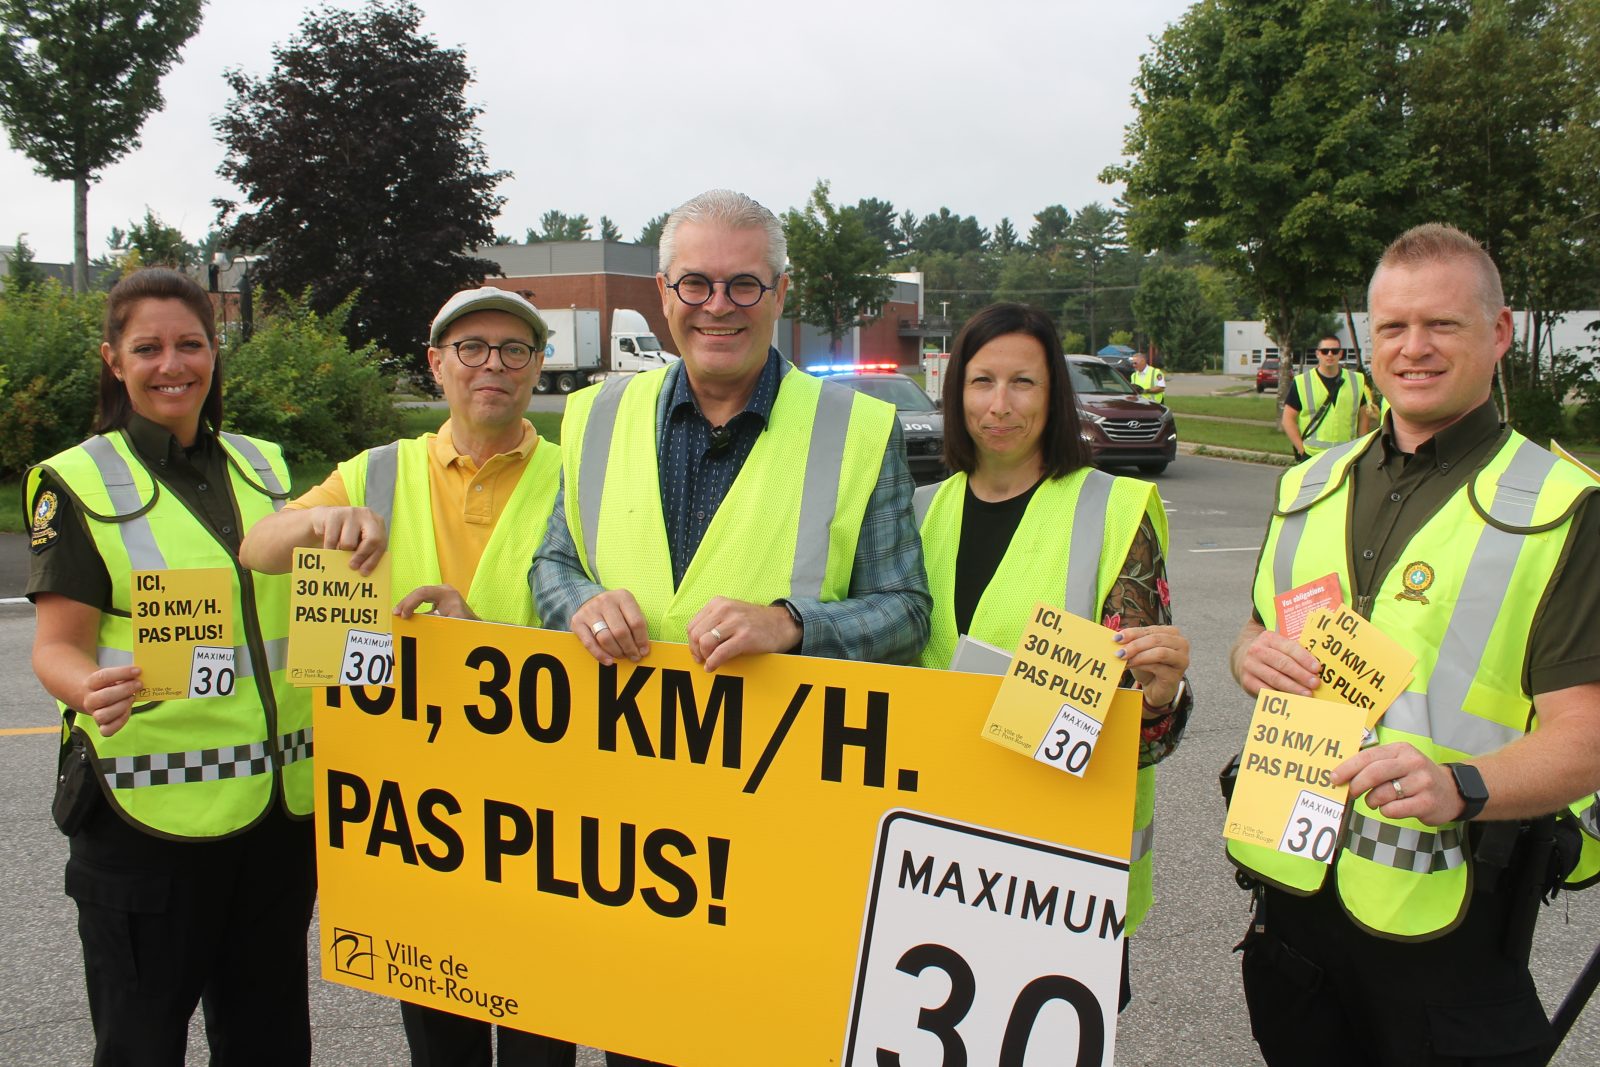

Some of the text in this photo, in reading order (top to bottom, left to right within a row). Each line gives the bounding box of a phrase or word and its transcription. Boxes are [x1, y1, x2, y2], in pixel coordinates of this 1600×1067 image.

[298, 554, 325, 573] ICI,
[137, 575, 165, 593] ICI,
[296, 580, 378, 600] 30 KM/H.
[137, 599, 221, 618] 30 KM/H.
[296, 606, 378, 624] PAS PLUS!
[1035, 608, 1062, 634] ICI,
[139, 624, 222, 643] PAS PLUS!
[1336, 612, 1358, 640] ICI,
[197, 652, 234, 661] MAXIMU
[346, 651, 386, 685] 30
[1024, 634, 1107, 680] 30 KM/H.
[1322, 635, 1386, 692] 30 KM/H.
[194, 667, 234, 696] 30
[1014, 661, 1102, 708] PAS PLUS!
[464, 646, 572, 744] 30
[598, 662, 918, 794] KM/H.
[1262, 696, 1290, 720] ICI,
[1044, 730, 1092, 772] 30
[1254, 724, 1343, 759] 30 KM/H.
[1246, 753, 1282, 776] PAS
[327, 768, 731, 926] PAS PLUS!
[1288, 818, 1336, 862] 30
[898, 850, 1126, 941] MAXIMUM
[386, 940, 468, 980] Ville de
[387, 964, 519, 1018] Pont-Rouge
[876, 943, 1105, 1067] 30
